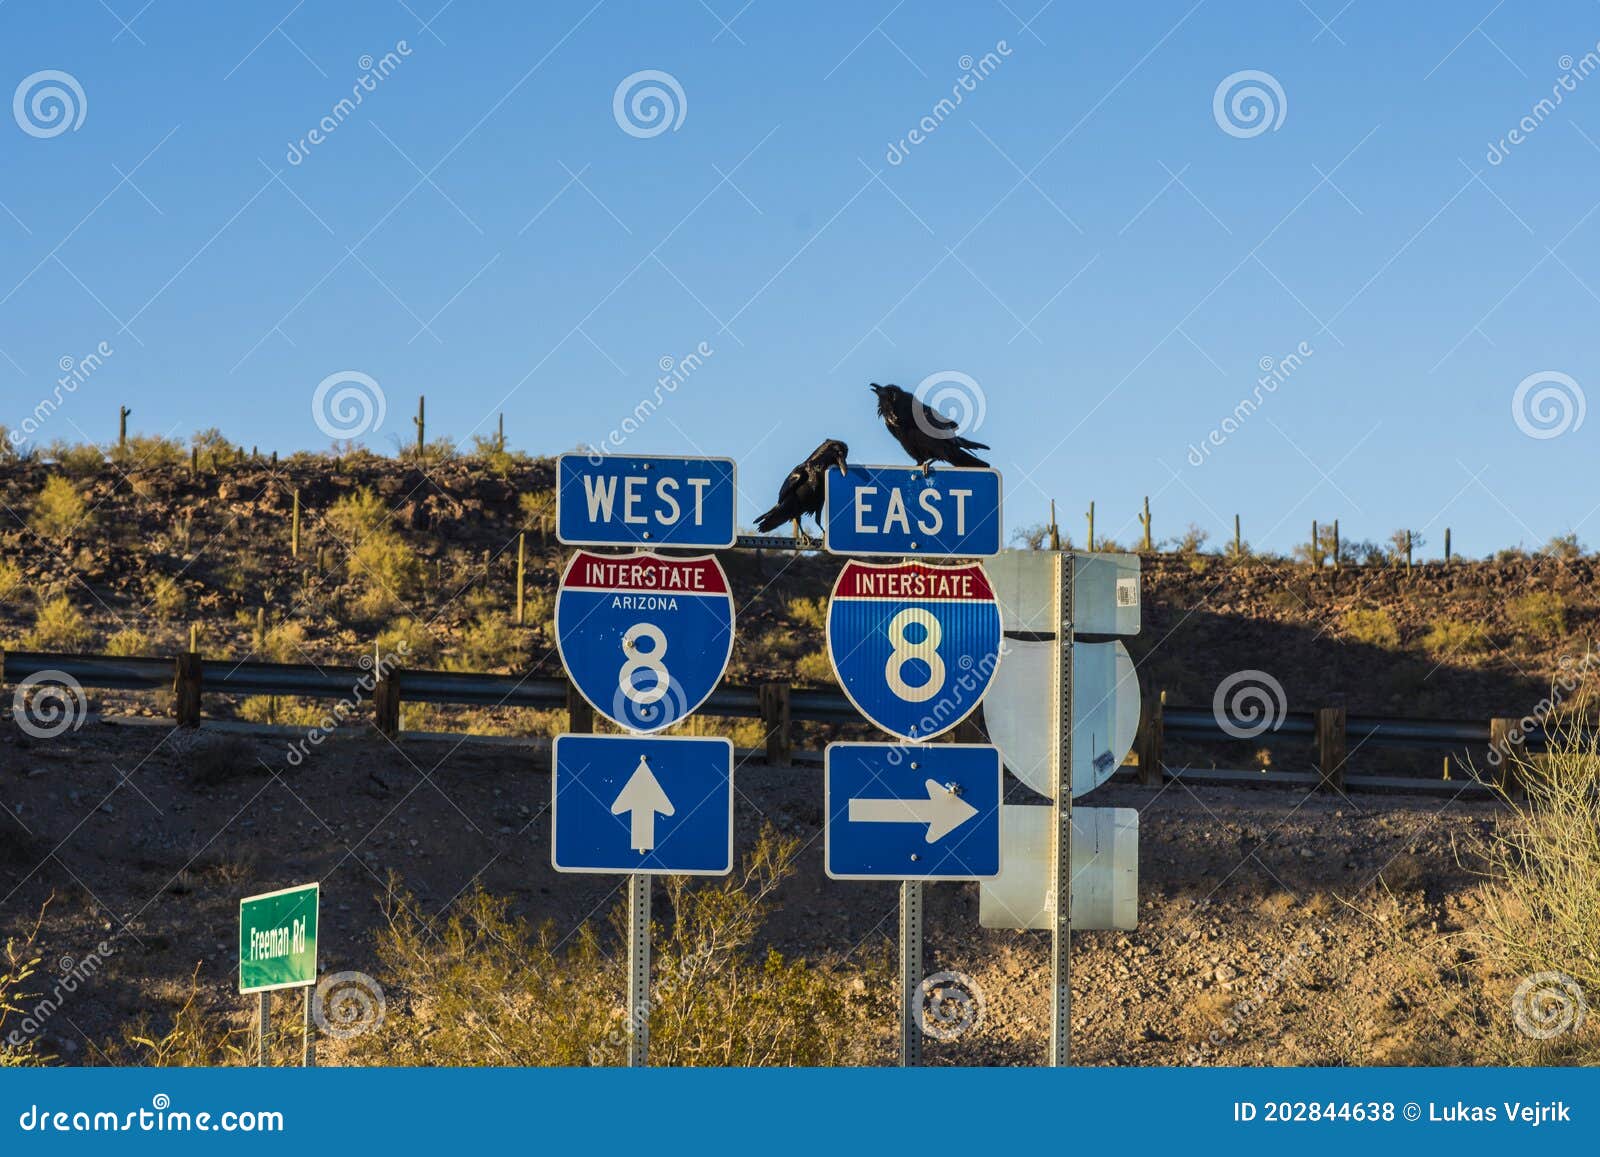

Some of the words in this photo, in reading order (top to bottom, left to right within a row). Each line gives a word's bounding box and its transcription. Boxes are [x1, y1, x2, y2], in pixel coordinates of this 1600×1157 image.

[584, 475, 711, 526] WEST
[855, 486, 973, 536] EAST
[586, 563, 705, 589] INTERSTATE
[856, 573, 973, 596] INTERSTATE
[612, 596, 678, 611] ARIZONA
[618, 622, 670, 704] 8
[885, 607, 946, 703] 8
[250, 926, 289, 961] Freeman
[292, 915, 306, 955] Rd
